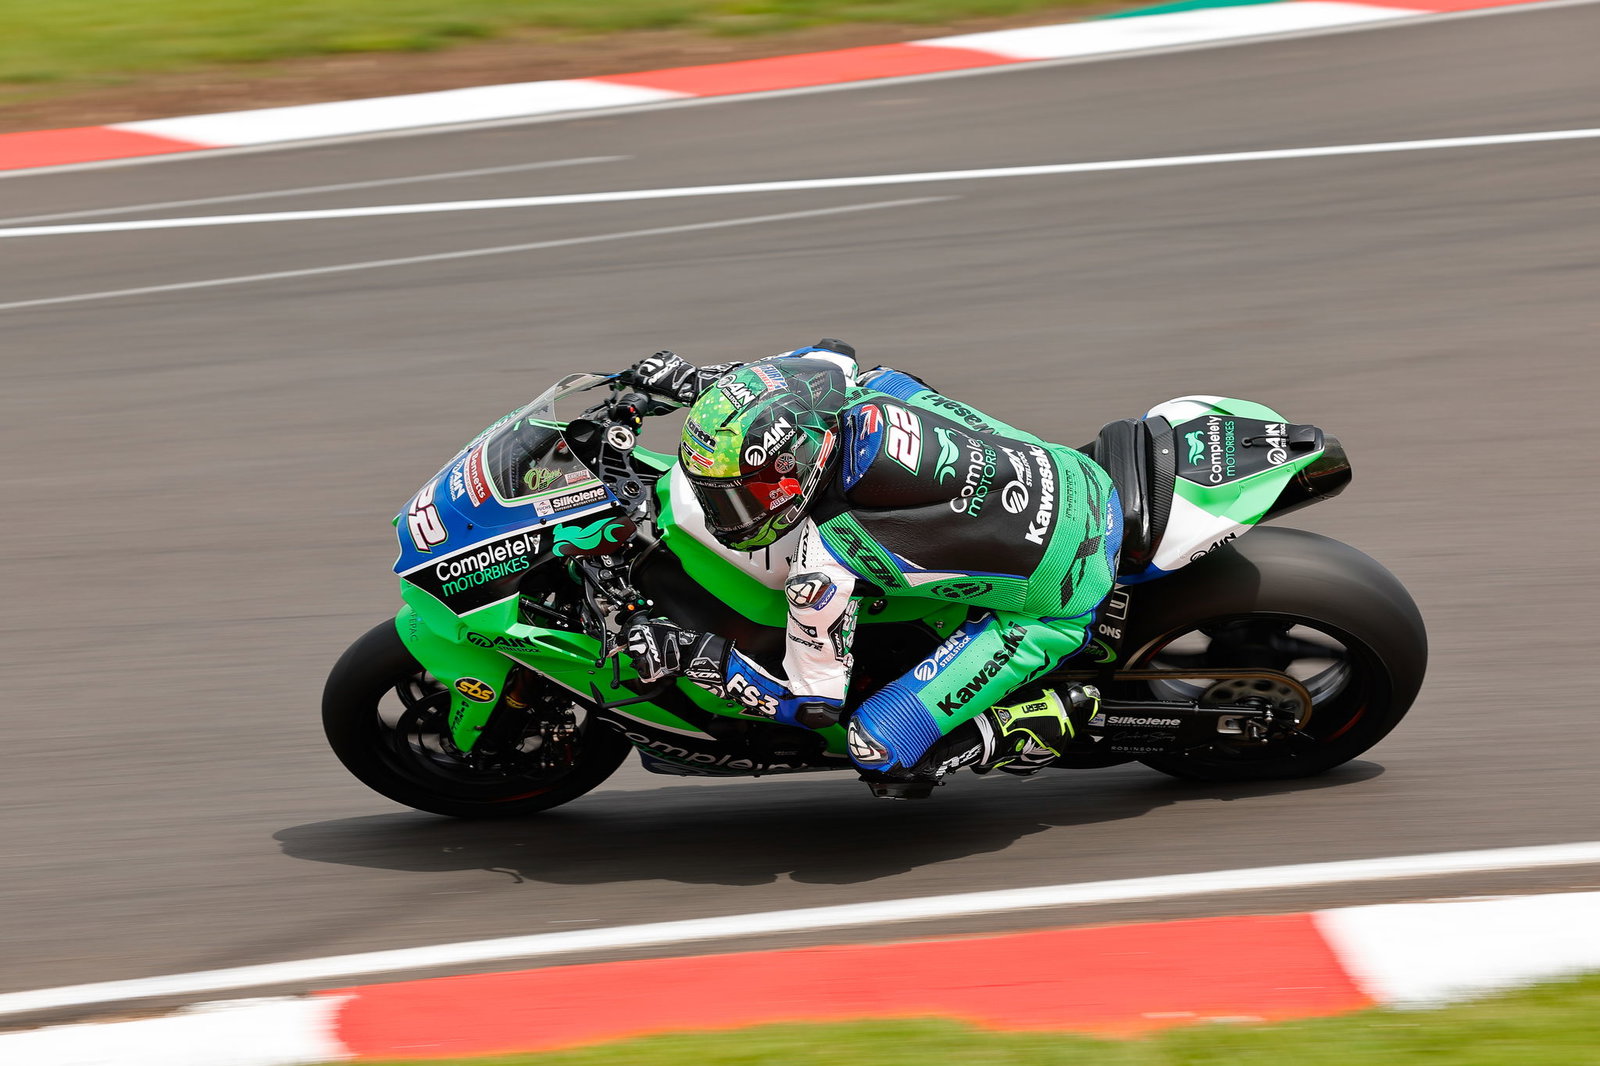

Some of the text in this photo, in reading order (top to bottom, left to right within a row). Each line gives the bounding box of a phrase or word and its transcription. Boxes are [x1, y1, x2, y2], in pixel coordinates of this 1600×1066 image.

[768, 429, 796, 456] STEELSTOCK
[883, 404, 923, 476] 22
[1206, 415, 1223, 483] Completely
[471, 452, 486, 499] Bennetts
[552, 488, 605, 509] Silkolene
[1024, 443, 1054, 545] Kawasaki
[436, 534, 540, 581] Completely
[936, 620, 1028, 717] Kawasaki
[939, 635, 972, 667] STEELSTOCK
[457, 681, 493, 700] sbs
[1107, 716, 1181, 726] Silkolene
